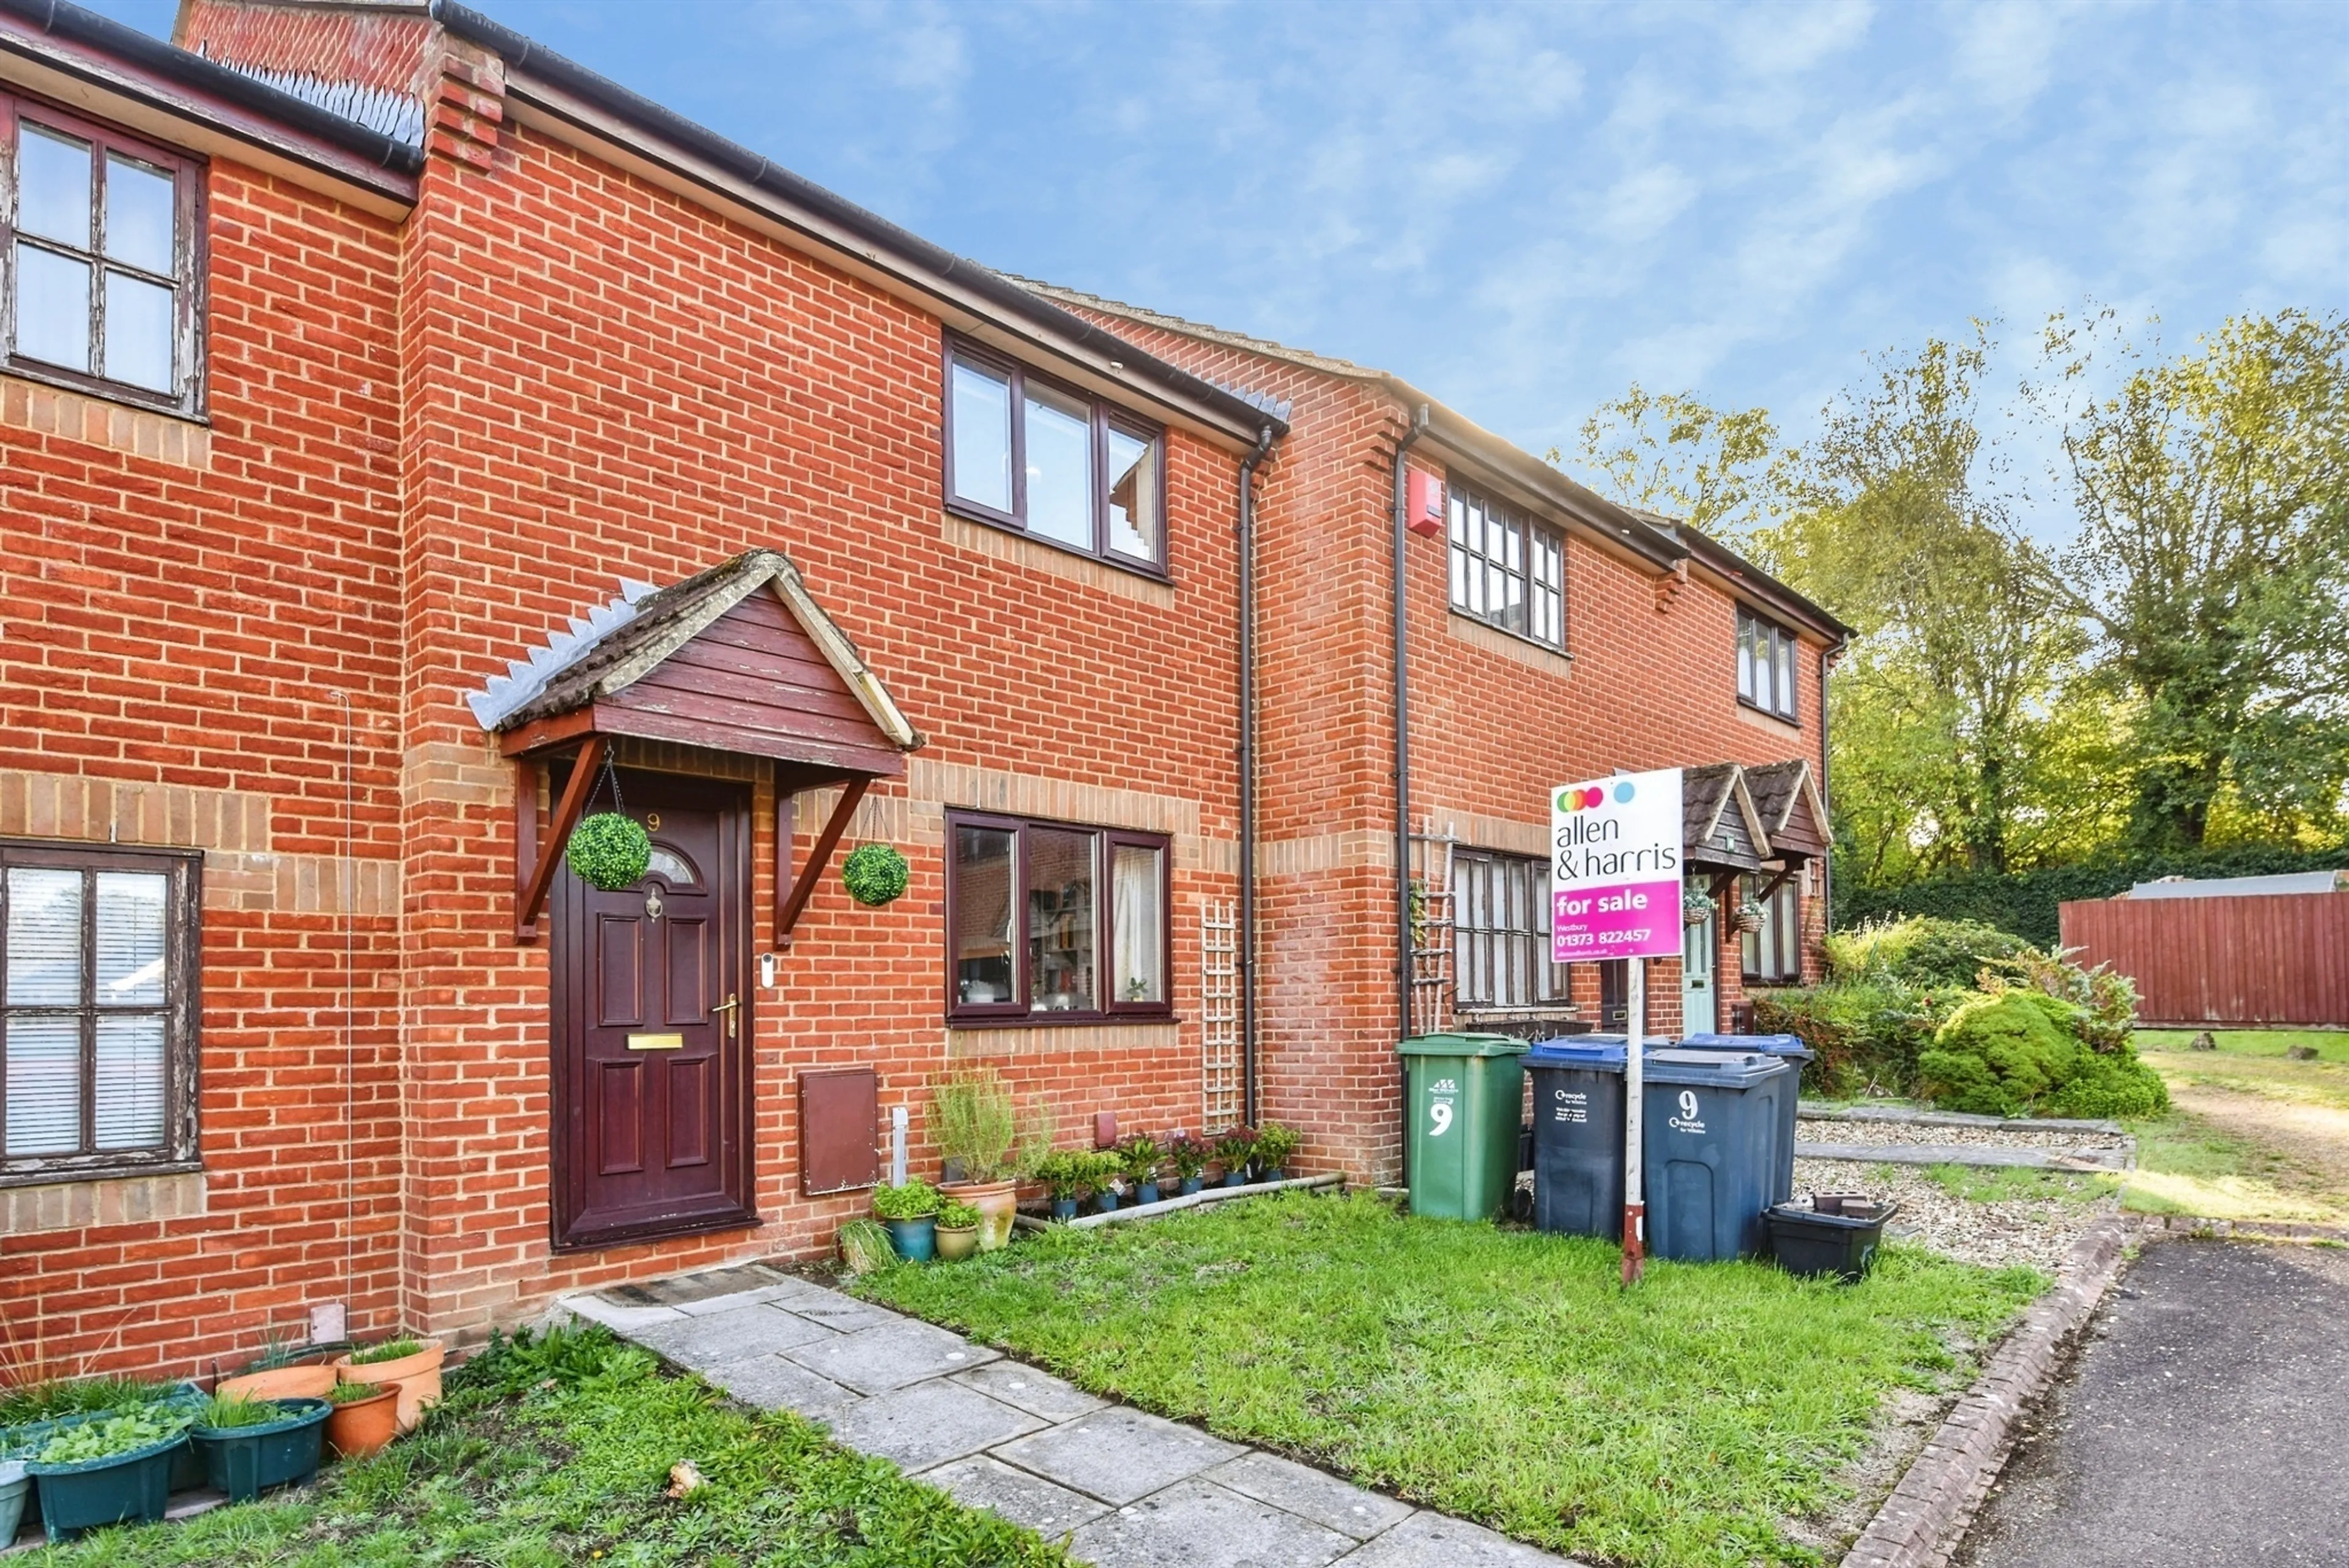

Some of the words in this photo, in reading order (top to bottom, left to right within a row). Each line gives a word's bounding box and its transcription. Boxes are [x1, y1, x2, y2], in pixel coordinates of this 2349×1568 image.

[647, 813, 660, 831] 9
[1557, 815, 1619, 848] allen
[1557, 849, 1578, 881] &
[1586, 842, 1676, 877] harris
[1556, 895, 1592, 916] for
[1597, 888, 1648, 913] sale
[1557, 933, 1594, 947] 01373
[1598, 929, 1651, 944] 822457
[1429, 1104, 1453, 1136] 9
[1679, 1090, 1698, 1120] 9
